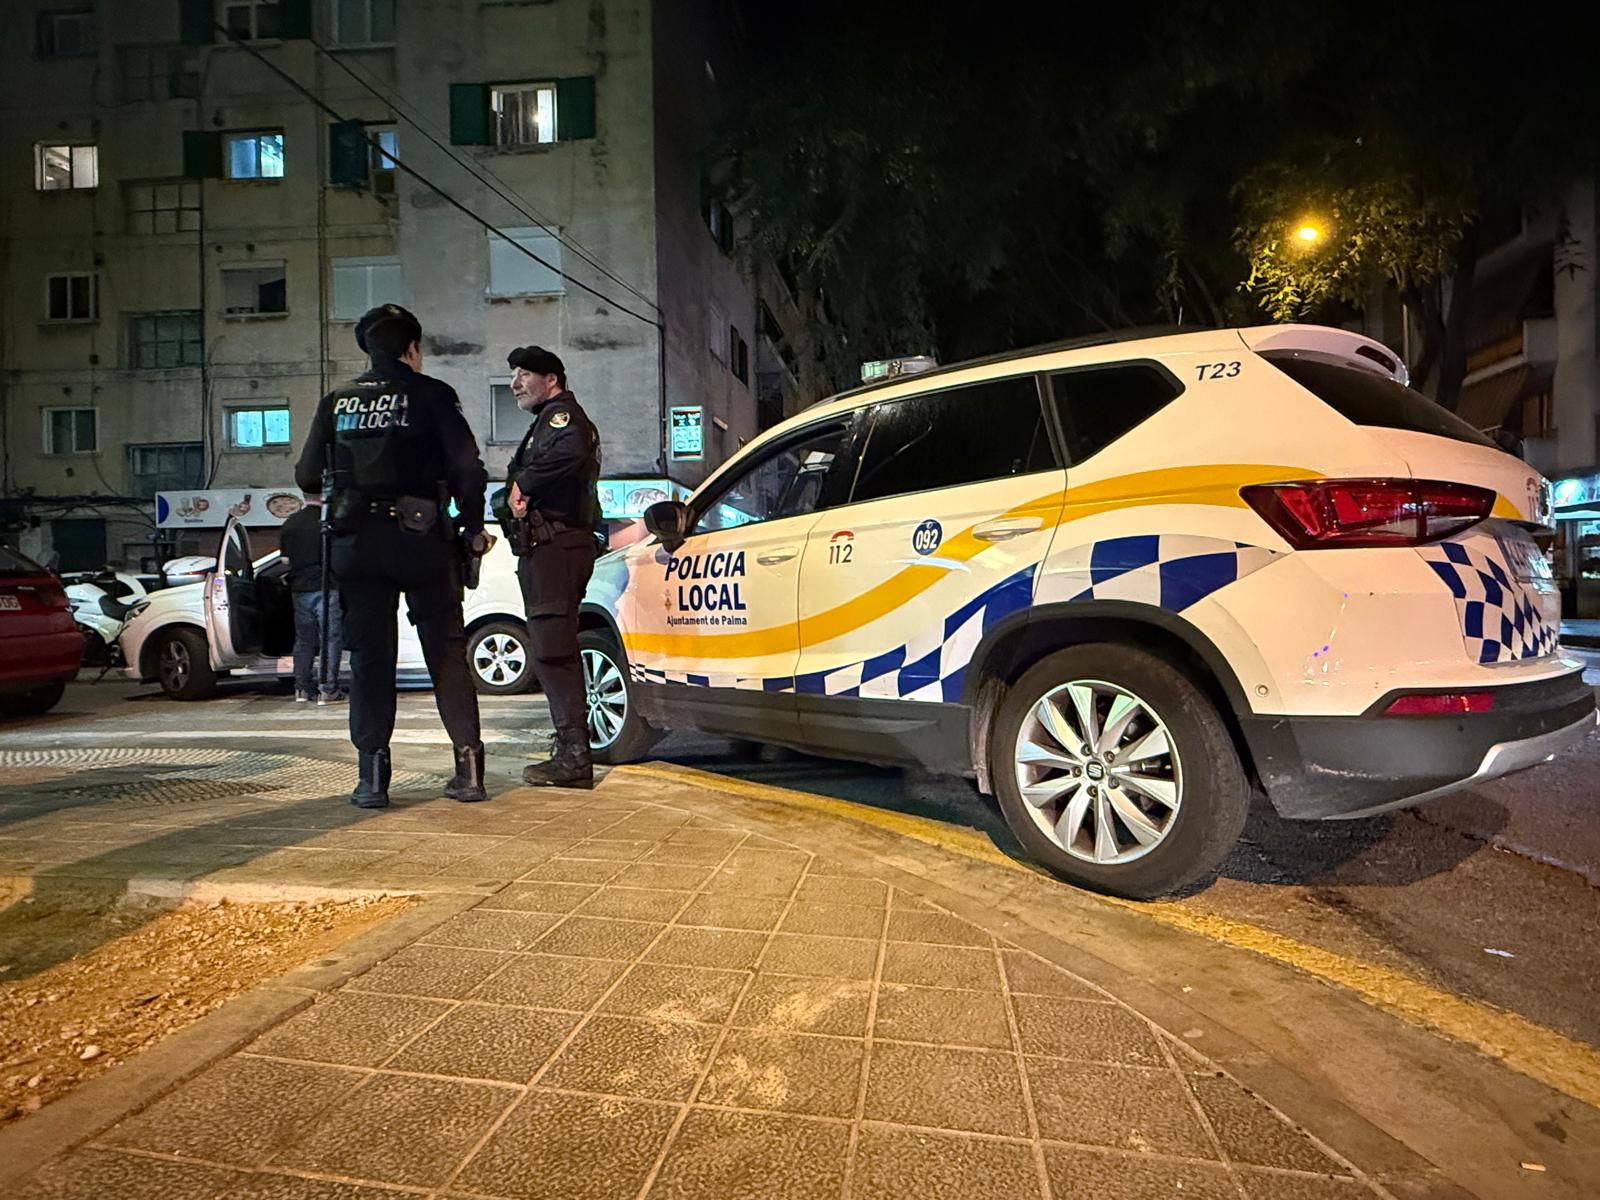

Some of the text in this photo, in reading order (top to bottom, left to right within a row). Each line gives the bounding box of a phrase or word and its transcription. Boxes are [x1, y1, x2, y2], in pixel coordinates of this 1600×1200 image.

[1195, 361, 1242, 381] T23
[358, 411, 409, 429] LOCL
[915, 528, 939, 550] 092
[829, 544, 853, 565] 112
[664, 551, 746, 581] POLICIA
[678, 583, 747, 611] LOCAL
[667, 615, 747, 627] Ajuntament de Palma
